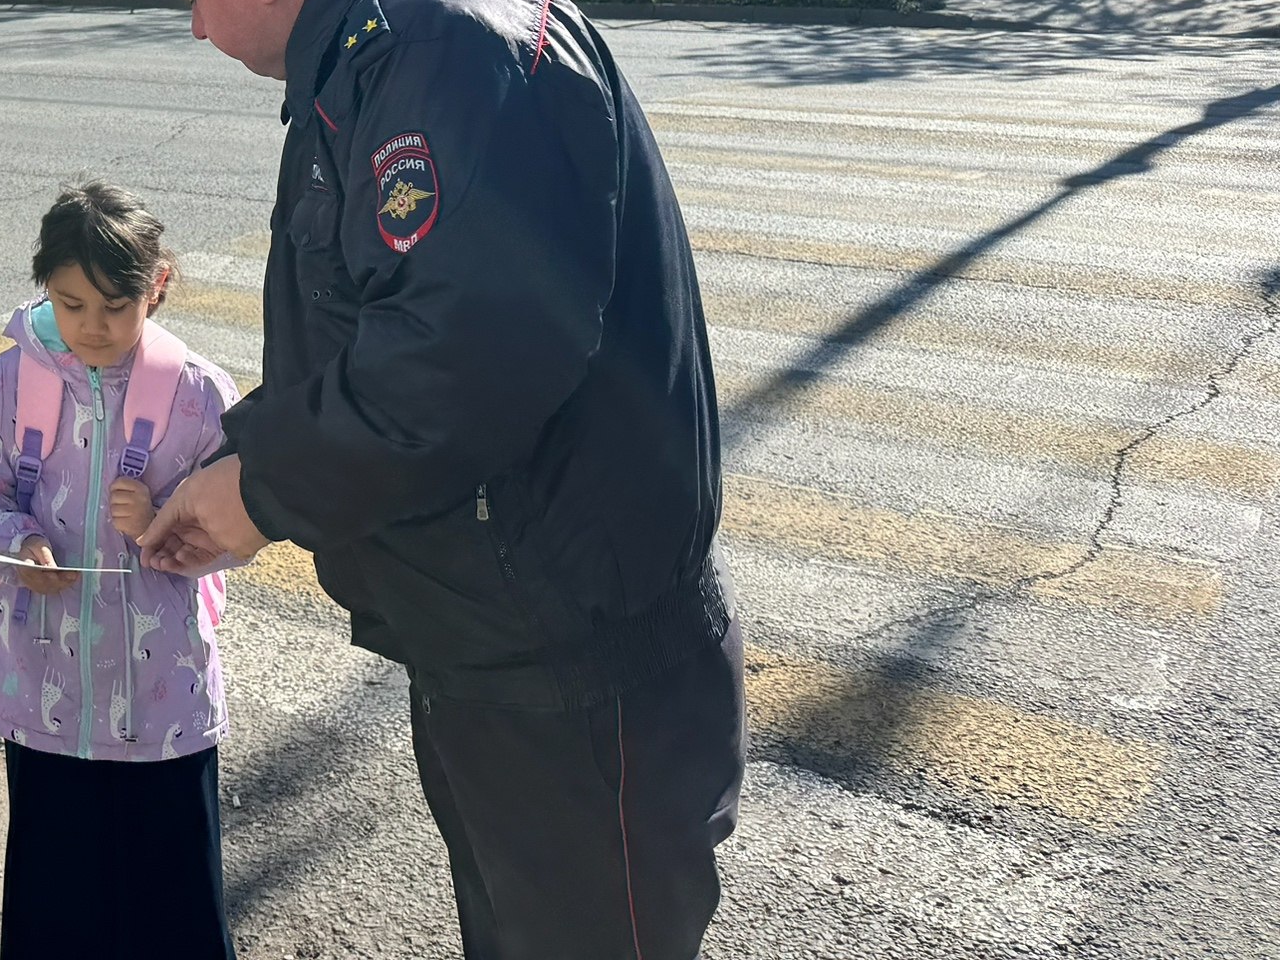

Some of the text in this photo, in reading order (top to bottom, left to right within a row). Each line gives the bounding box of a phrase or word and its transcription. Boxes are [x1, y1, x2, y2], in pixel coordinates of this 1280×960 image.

[373, 135, 422, 168] ПОЛИЦИЯ
[379, 158, 425, 191] РОССИЯ
[393, 233, 418, 252] МВД
